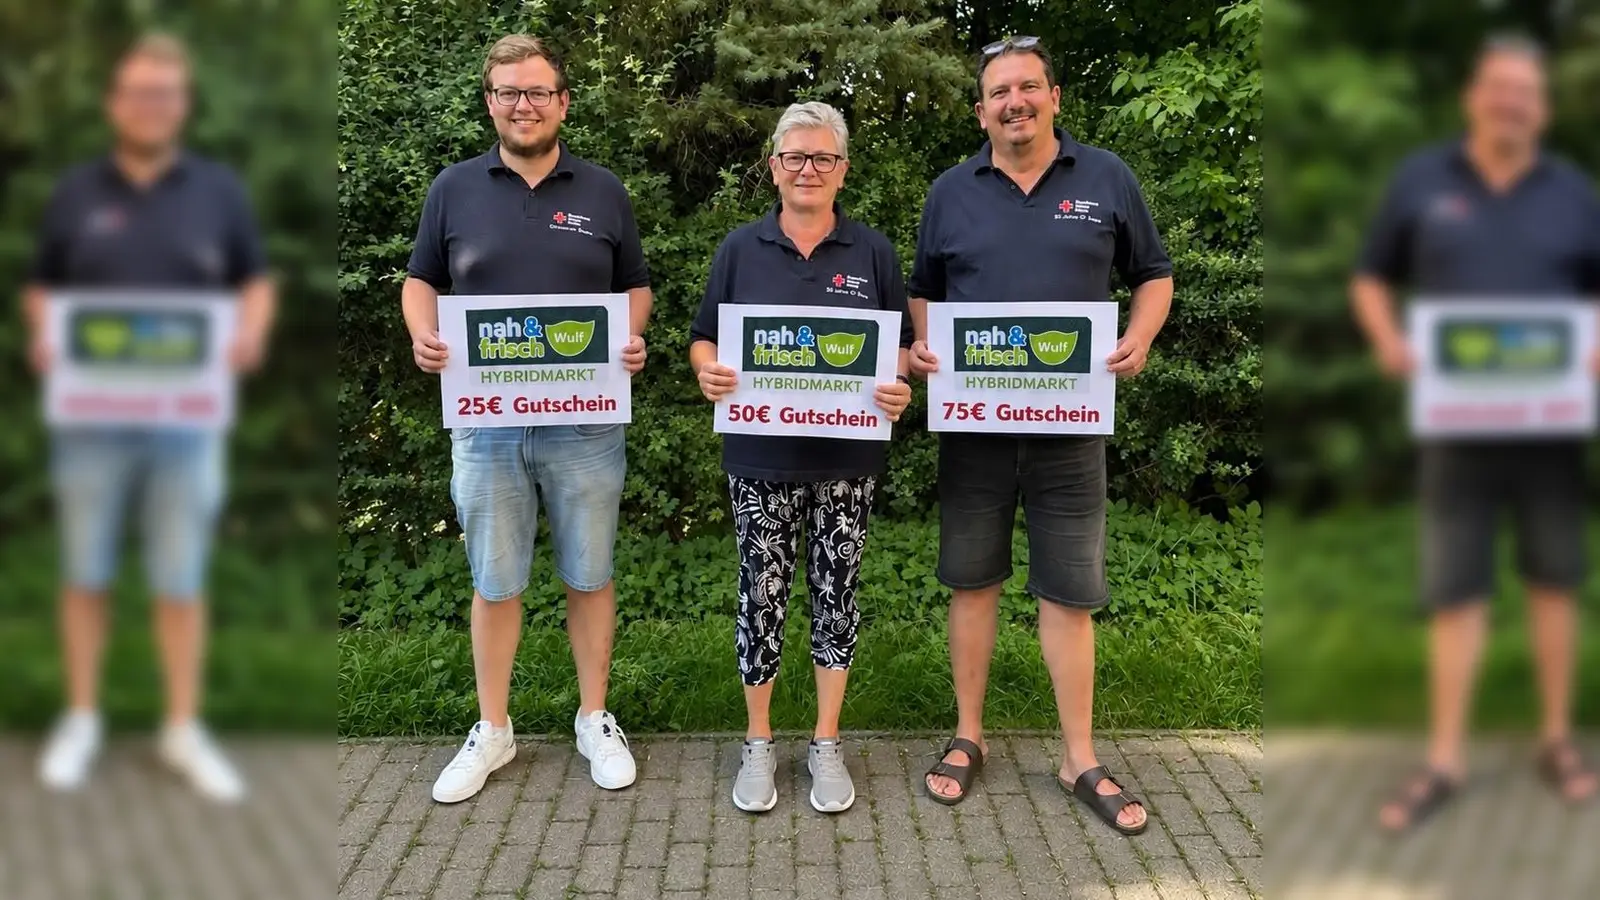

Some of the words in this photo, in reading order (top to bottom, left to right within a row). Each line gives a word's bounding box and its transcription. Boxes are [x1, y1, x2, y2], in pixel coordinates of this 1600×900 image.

[554, 331, 584, 343] Wulf
[478, 337, 545, 359] frisch
[753, 345, 816, 367] frisch
[825, 343, 855, 355] Wulf
[964, 345, 1028, 366] frisch
[1038, 341, 1068, 353] Wulf
[481, 368, 597, 384] HYBRIDMARKT
[753, 377, 863, 393] HYBRIDMARKT
[966, 376, 1078, 390] HYBRIDMARKT
[458, 396, 503, 416] 25€
[513, 394, 617, 414] Gutschein
[942, 402, 986, 421] 75€
[996, 404, 1100, 423] Gutschein
[728, 404, 771, 423] 50€
[779, 406, 878, 427] Gutschein
